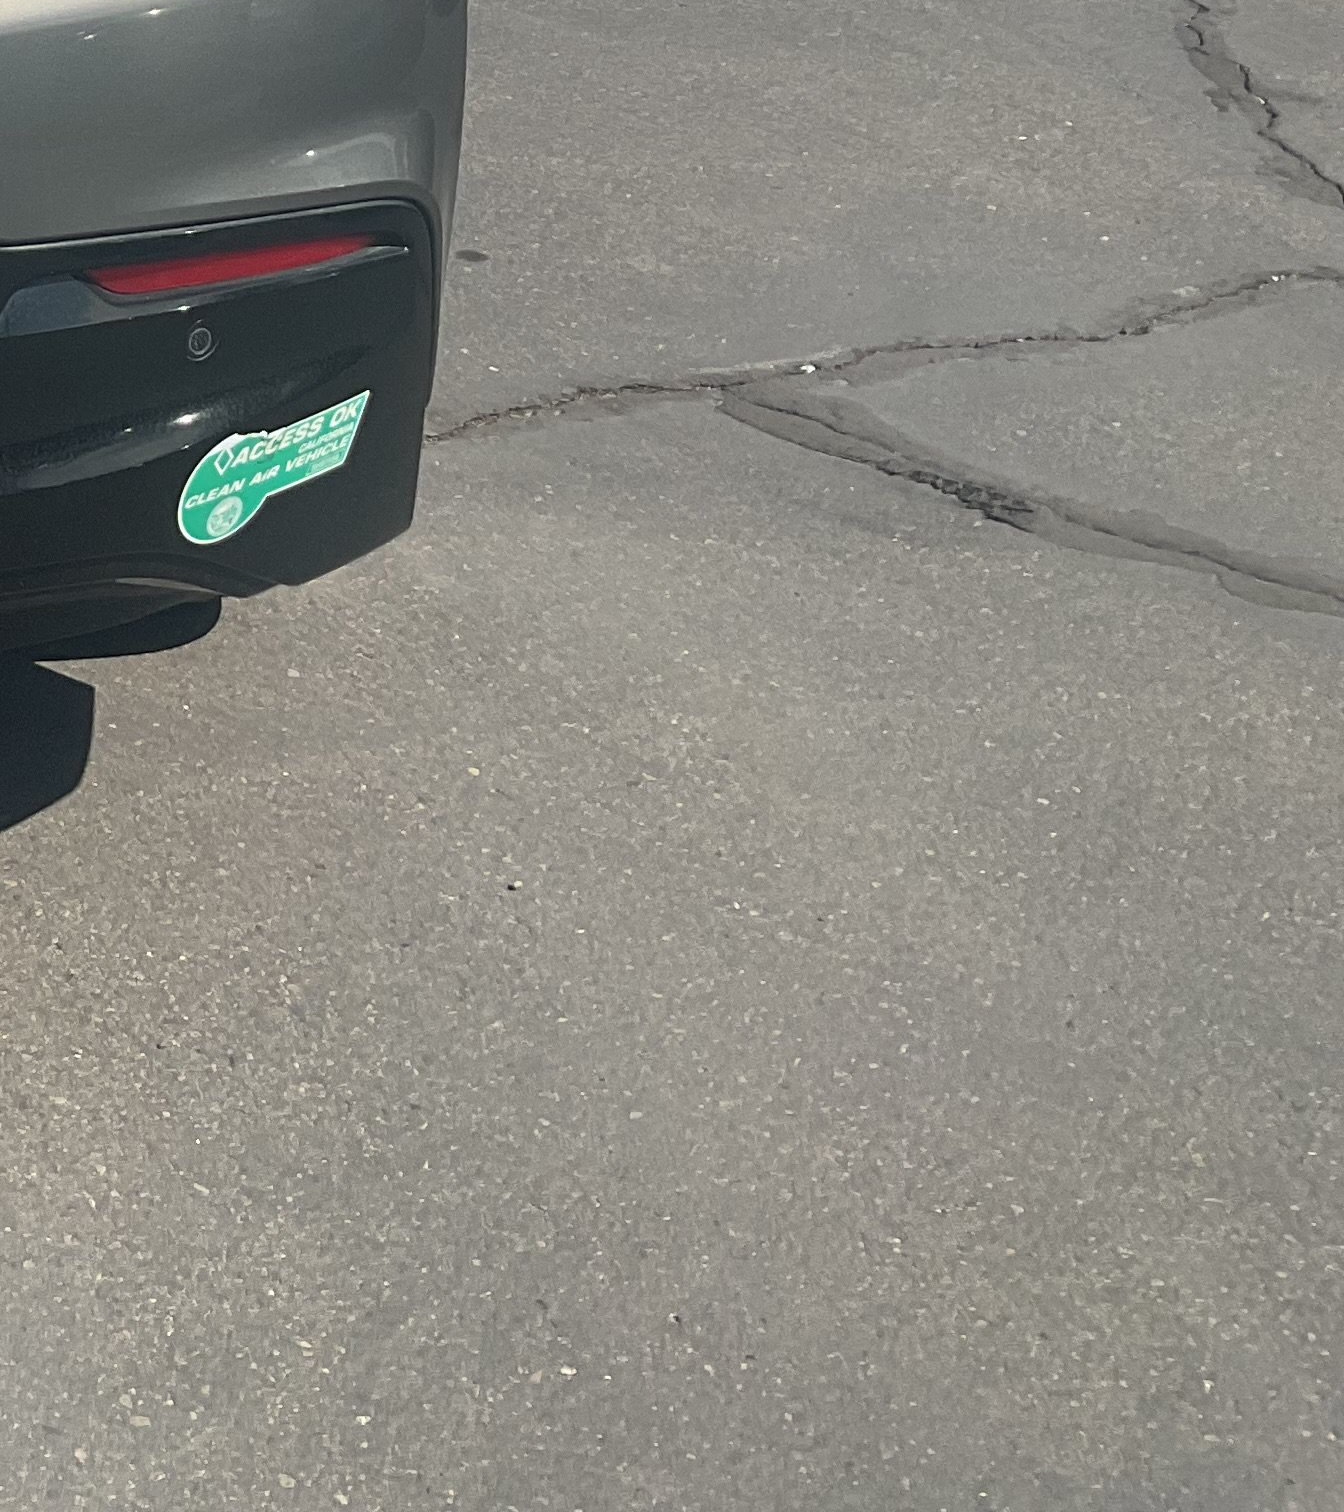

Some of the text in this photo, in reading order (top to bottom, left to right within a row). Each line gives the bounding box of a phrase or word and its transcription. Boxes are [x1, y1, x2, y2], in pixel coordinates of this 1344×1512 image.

[231, 416, 324, 468] ACCESS
[329, 399, 362, 427] OK
[185, 478, 245, 509] CLEAN
[249, 465, 280, 486] AIR
[285, 435, 349, 472] VEHICLE
